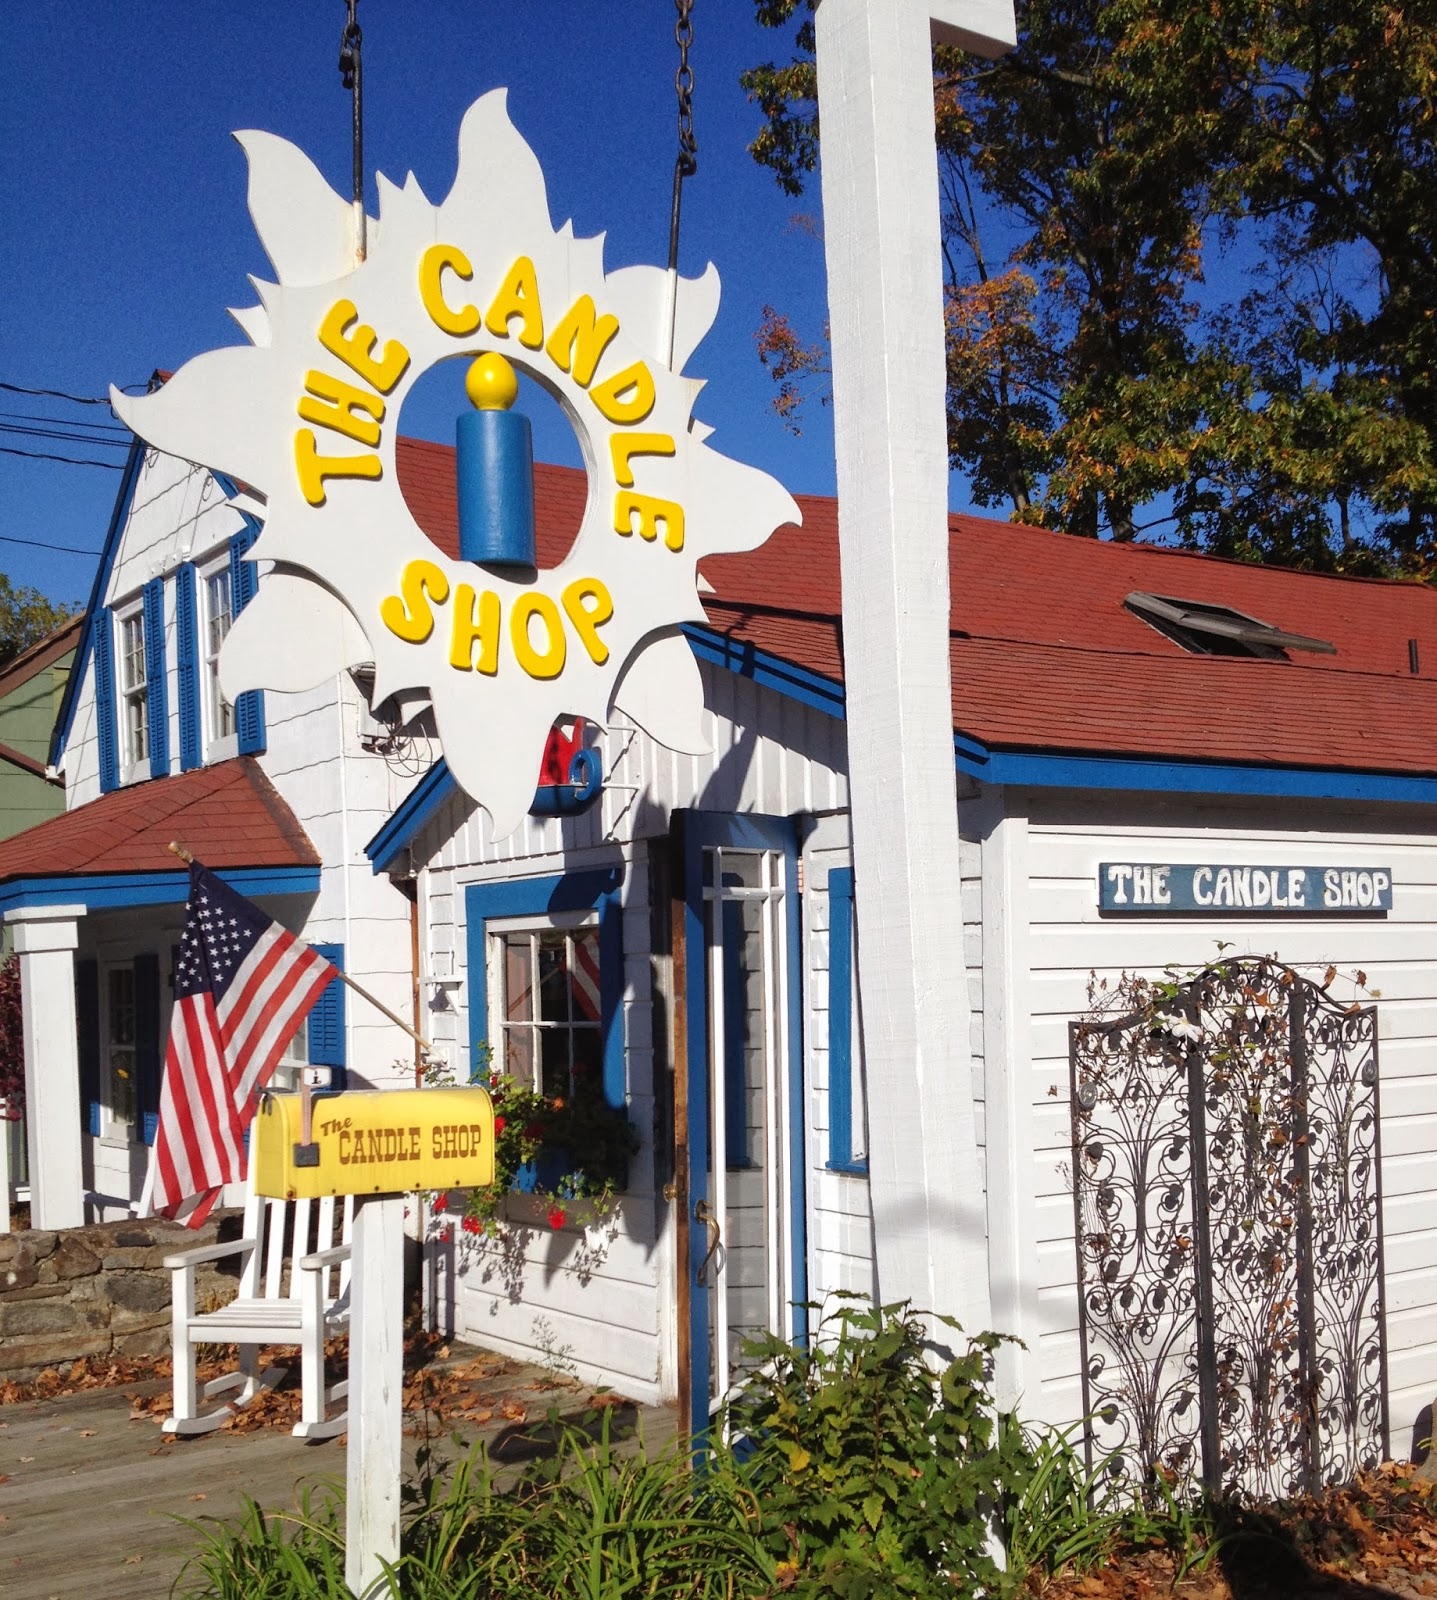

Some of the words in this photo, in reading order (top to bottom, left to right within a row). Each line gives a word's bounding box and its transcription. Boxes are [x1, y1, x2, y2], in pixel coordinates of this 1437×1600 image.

[294, 299, 411, 506] THE
[419, 244, 685, 552] CANDLE
[379, 560, 614, 679] SHOP
[1108, 865, 1171, 904] THE
[1192, 867, 1305, 907] CANDLE
[1324, 869, 1389, 907] SHOP
[320, 1117, 352, 1137] The
[339, 1127, 421, 1165] CANDLE
[432, 1124, 481, 1159] SHOP
